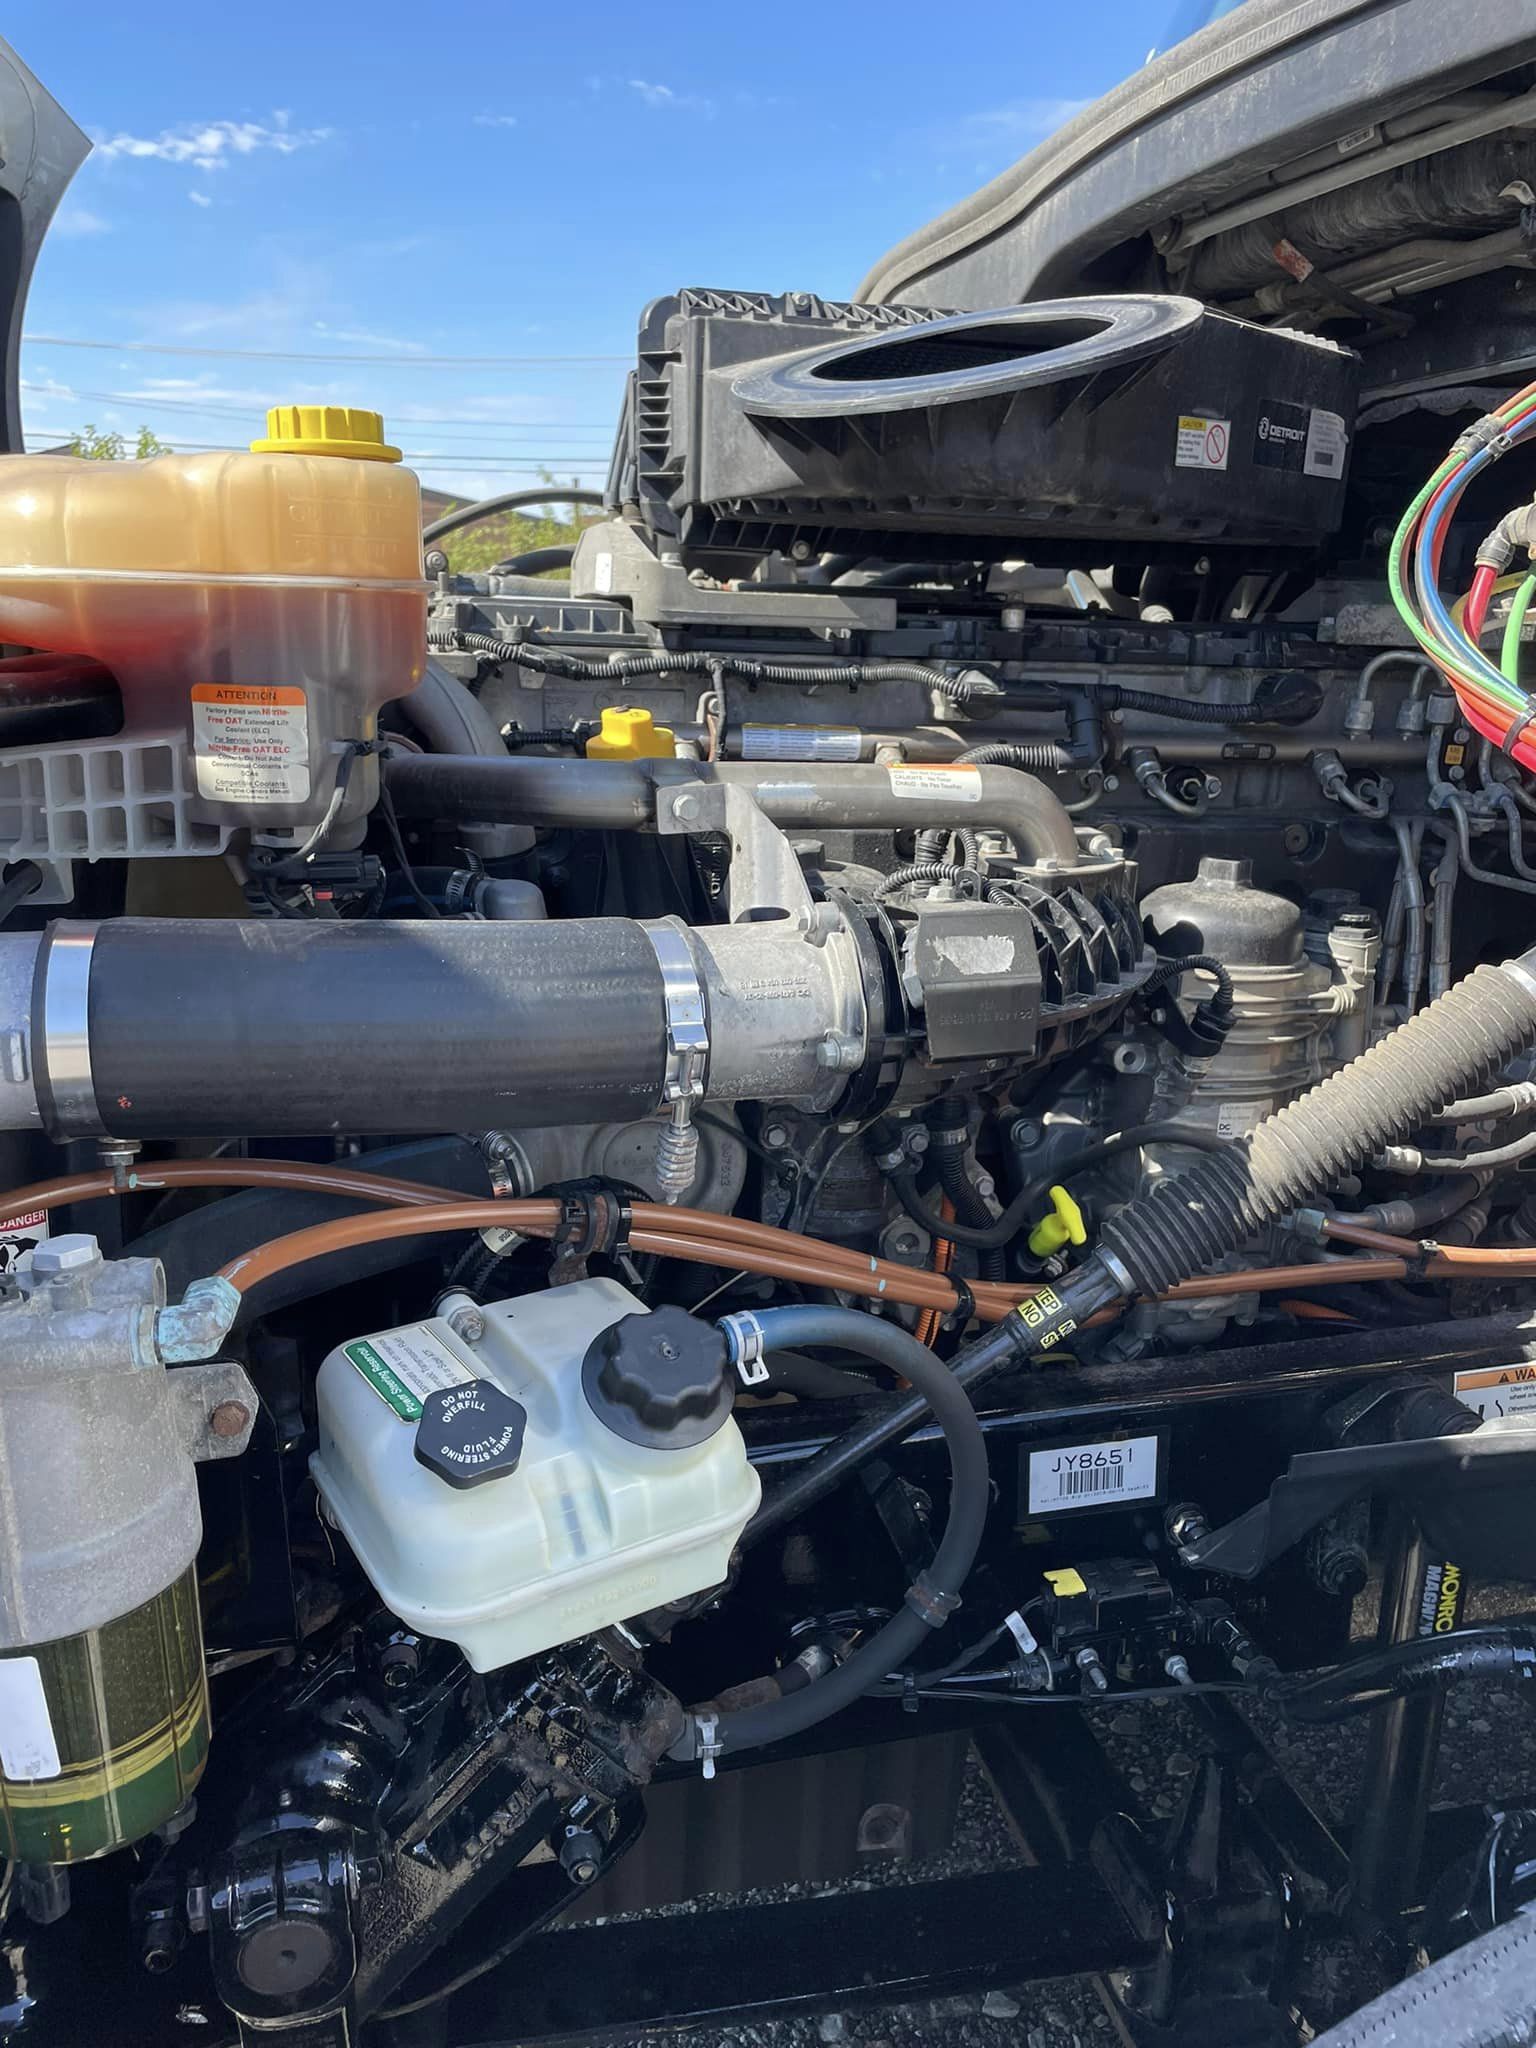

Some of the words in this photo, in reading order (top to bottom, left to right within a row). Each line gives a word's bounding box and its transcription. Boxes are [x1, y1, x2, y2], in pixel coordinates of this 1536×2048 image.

[1269, 425, 1306, 442] DETROIT
[216, 690, 276, 700] ATTENTION
[208, 716, 224, 724] Free
[225, 716, 242, 724] OAT
[225, 726, 250, 734] Coolant
[252, 745, 270, 754] OAT
[272, 746, 290, 754] ELC
[268, 738, 284, 746] Only
[211, 760, 252, 768] Conventional
[252, 762, 282, 770] Coolants
[216, 778, 252, 788] Compatible
[226, 786, 244, 794] Engine
[1022, 1304, 1040, 1323] NO
[356, 1346, 382, 1374] Reservoir
[380, 1370, 402, 1395] Steering
[1515, 1368, 1536, 1381] WA
[398, 1392, 416, 1413] Power
[442, 1395, 456, 1407] DO
[458, 1390, 478, 1400] NOT
[442, 1400, 486, 1423] OVERFILL
[463, 1436, 497, 1453] FLUID
[490, 1426, 513, 1456] POWER
[440, 1446, 490, 1464] STEERING
[1052, 1448, 1132, 1472] JY8651
[1435, 1561, 1461, 1632] MONRO
